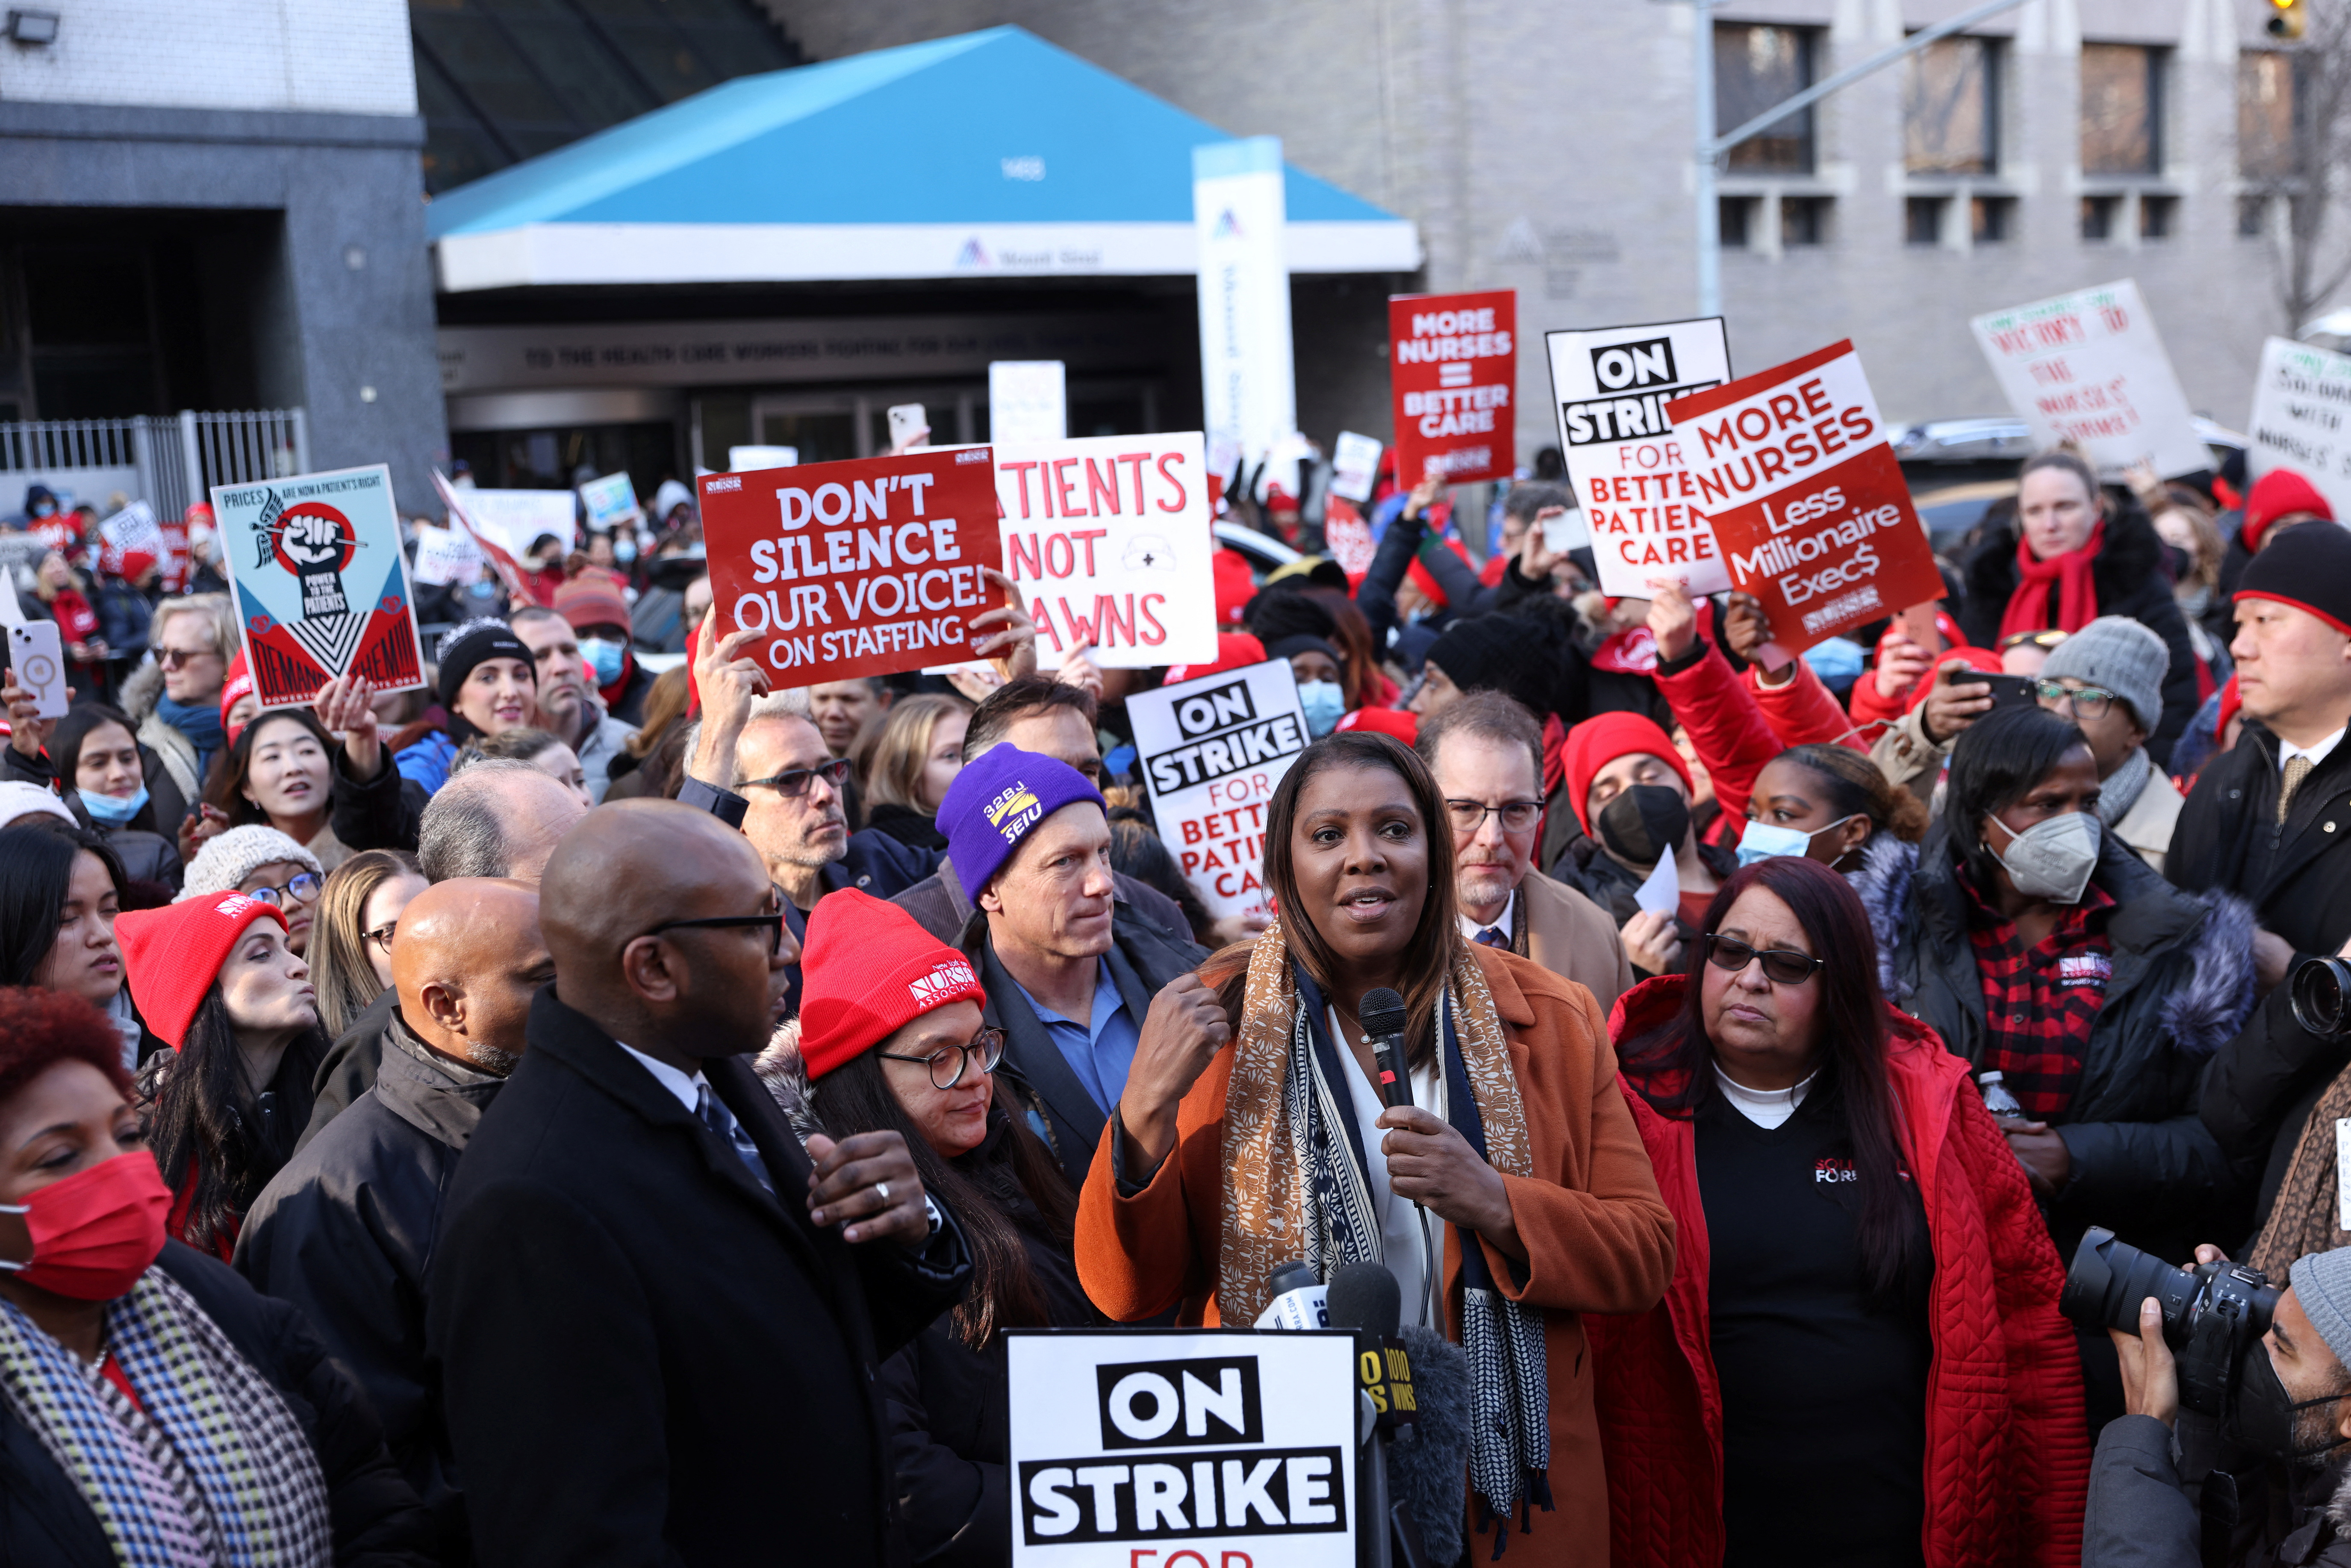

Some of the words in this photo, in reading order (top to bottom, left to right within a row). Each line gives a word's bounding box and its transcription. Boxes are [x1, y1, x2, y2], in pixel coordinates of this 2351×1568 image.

[1412, 307, 1496, 338] MORE
[2095, 304, 2130, 337] TO
[1397, 331, 1513, 365] NURSES
[1596, 342, 1670, 389] ON
[2029, 356, 2077, 388] THE
[1403, 384, 1509, 417] BETTER
[1697, 378, 1833, 460] MORE
[2289, 401, 2343, 431] WITH
[1418, 409, 1496, 438] CARE
[1619, 442, 1684, 469] FOR
[1695, 405, 1874, 505] NURSES
[224, 490, 265, 509] PRICES
[282, 487, 296, 500] ARE
[705, 478, 742, 491] NURSES
[776, 473, 934, 531] DON'T
[996, 452, 1186, 519] TIENTS
[1590, 471, 1696, 503] BETTE
[1590, 503, 1708, 533] PATIEN
[1761, 485, 1846, 535] Less
[750, 518, 961, 584] SILENCE
[1008, 528, 1107, 581] NOT
[1620, 533, 1713, 565] CARE
[1730, 503, 1900, 586] Millionaire
[305, 572, 336, 588] POWER
[310, 585, 319, 596] TO
[320, 583, 336, 595] THE
[1778, 543, 1880, 607] Exec$
[303, 593, 346, 615] PATIENTS
[734, 584, 832, 631] OUR
[835, 564, 987, 621] VOICE!
[1801, 588, 1879, 631] NURSES
[1030, 593, 1167, 652] AWNS
[769, 634, 815, 670] ON
[822, 615, 964, 662] STAFFING
[253, 638, 332, 696] DEMAND
[1179, 685, 1250, 735] ON
[1150, 718, 1297, 793] STRIKE
[984, 780, 1025, 818] 32BJ
[1208, 773, 1270, 807] FOR
[1005, 802, 1042, 844] SEIU
[1181, 799, 1271, 845] BETT
[1215, 868, 1261, 898] CA
[908, 966, 976, 1001] NURSES
[932, 963, 948, 971] New
[946, 959, 960, 967] York
[2341, 1141, 2351, 1205] PRESS
[1384, 1347, 1410, 1382] 1010
[1109, 1368, 1245, 1440] ON
[1390, 1383, 1417, 1411] WINS
[1029, 1456, 1337, 1536] STRIKE
